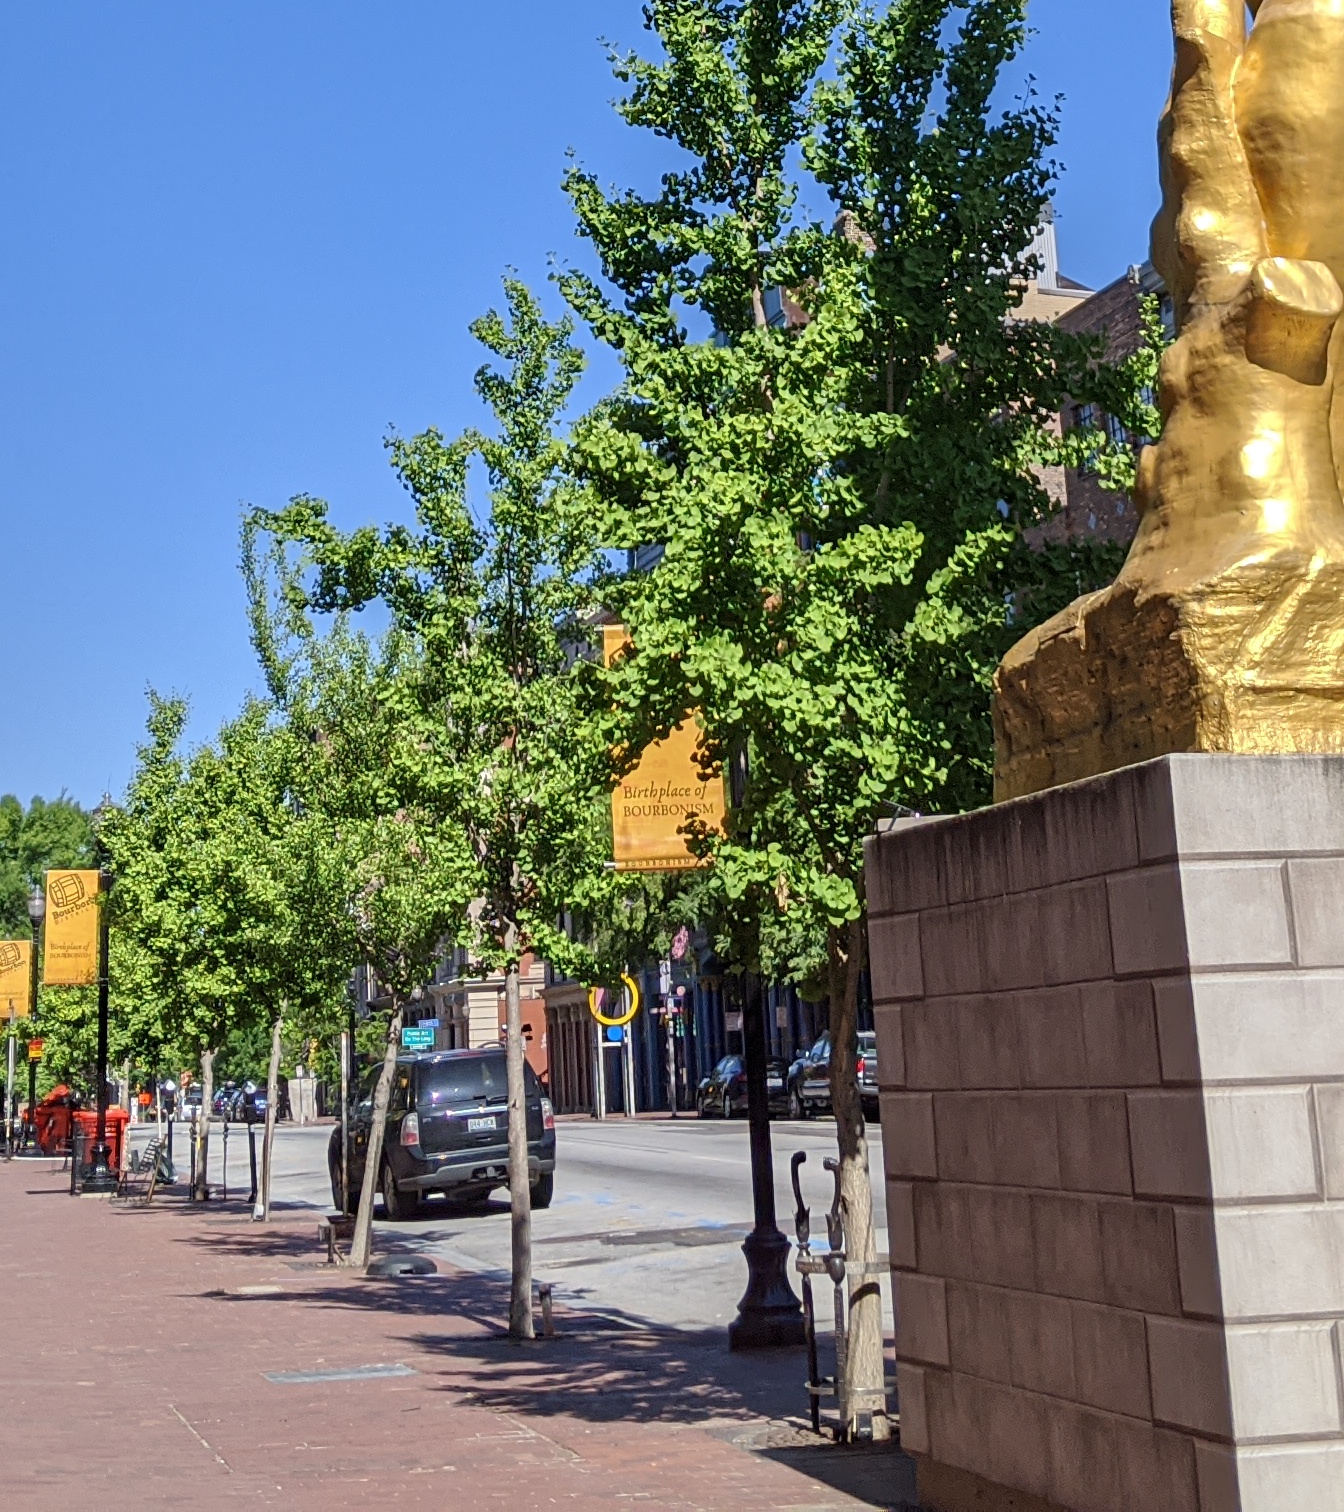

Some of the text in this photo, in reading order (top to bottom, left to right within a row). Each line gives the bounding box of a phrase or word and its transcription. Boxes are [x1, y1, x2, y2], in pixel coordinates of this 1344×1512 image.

[623, 779, 708, 803] Birthplace of
[623, 802, 714, 818] BOURBONISM
